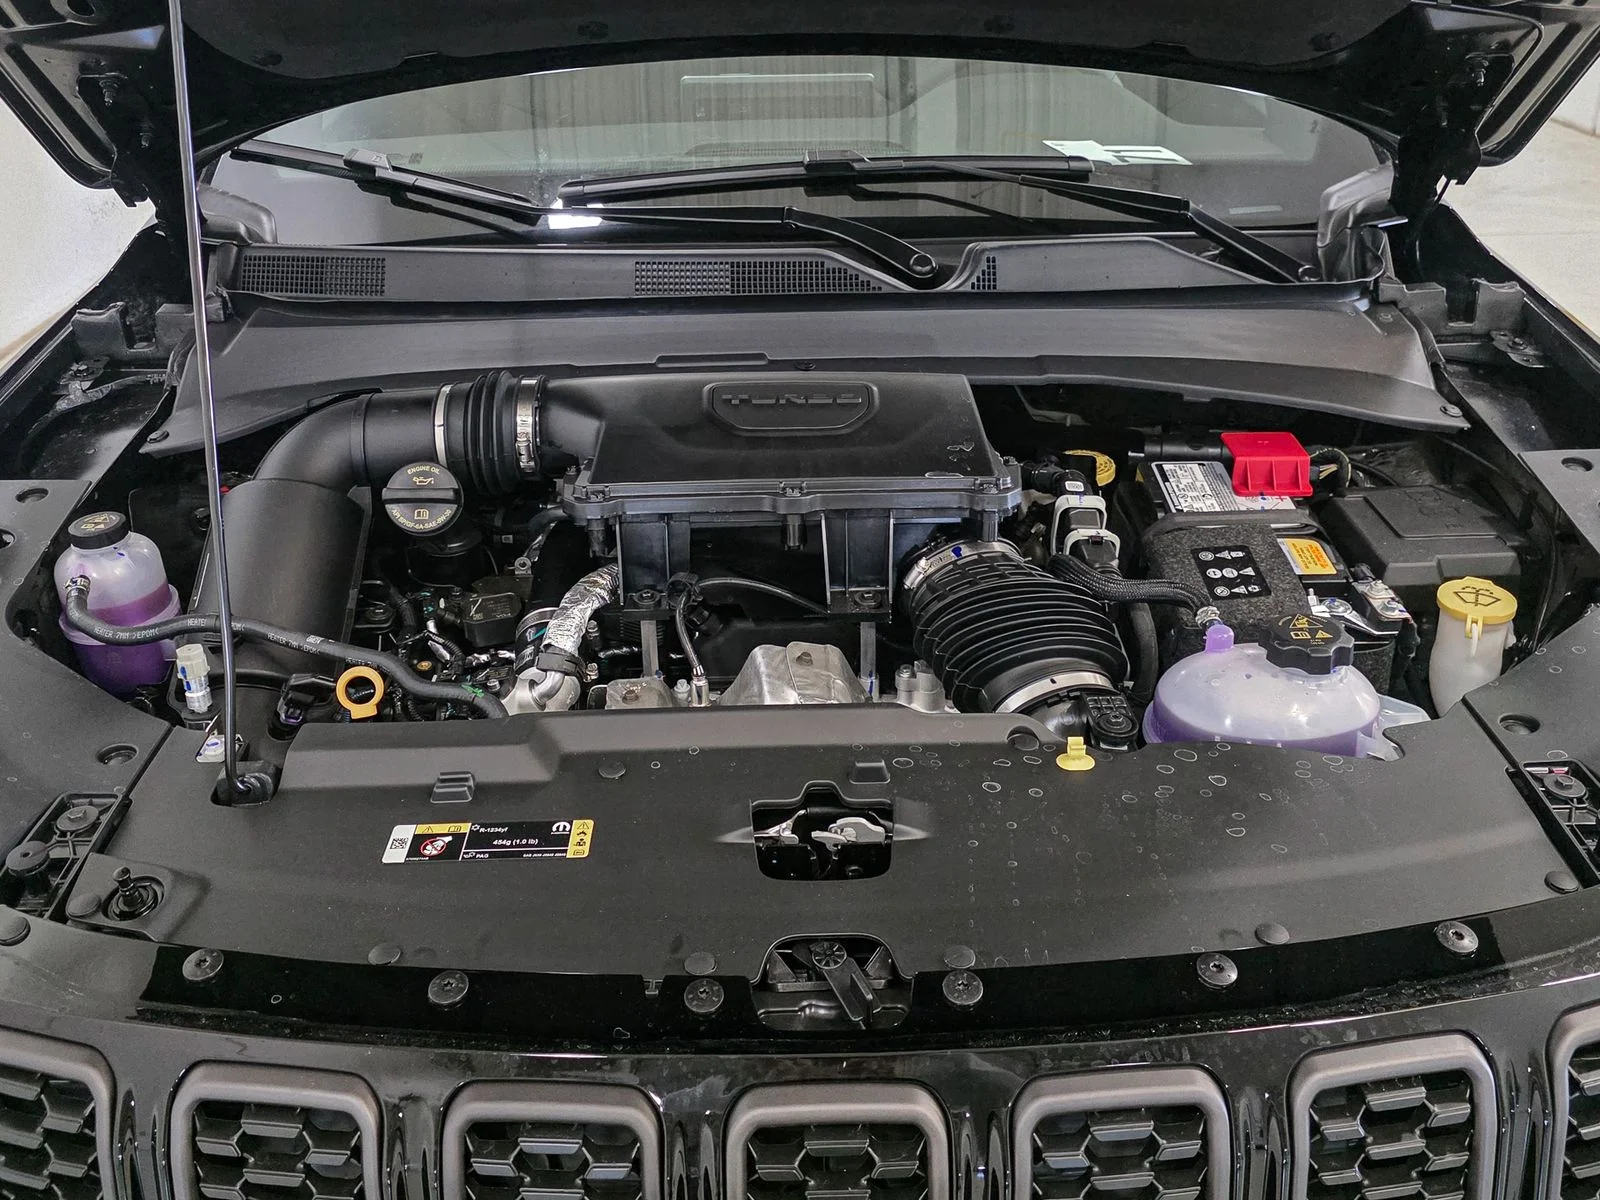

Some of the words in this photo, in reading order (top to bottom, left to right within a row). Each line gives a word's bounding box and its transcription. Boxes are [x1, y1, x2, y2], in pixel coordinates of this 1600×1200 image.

[407, 465, 431, 475] ENGINE
[430, 465, 441, 475] OIL
[94, 626, 114, 639] HEATER
[479, 826, 509, 834] R-1234yf
[528, 838, 539, 846] lb)
